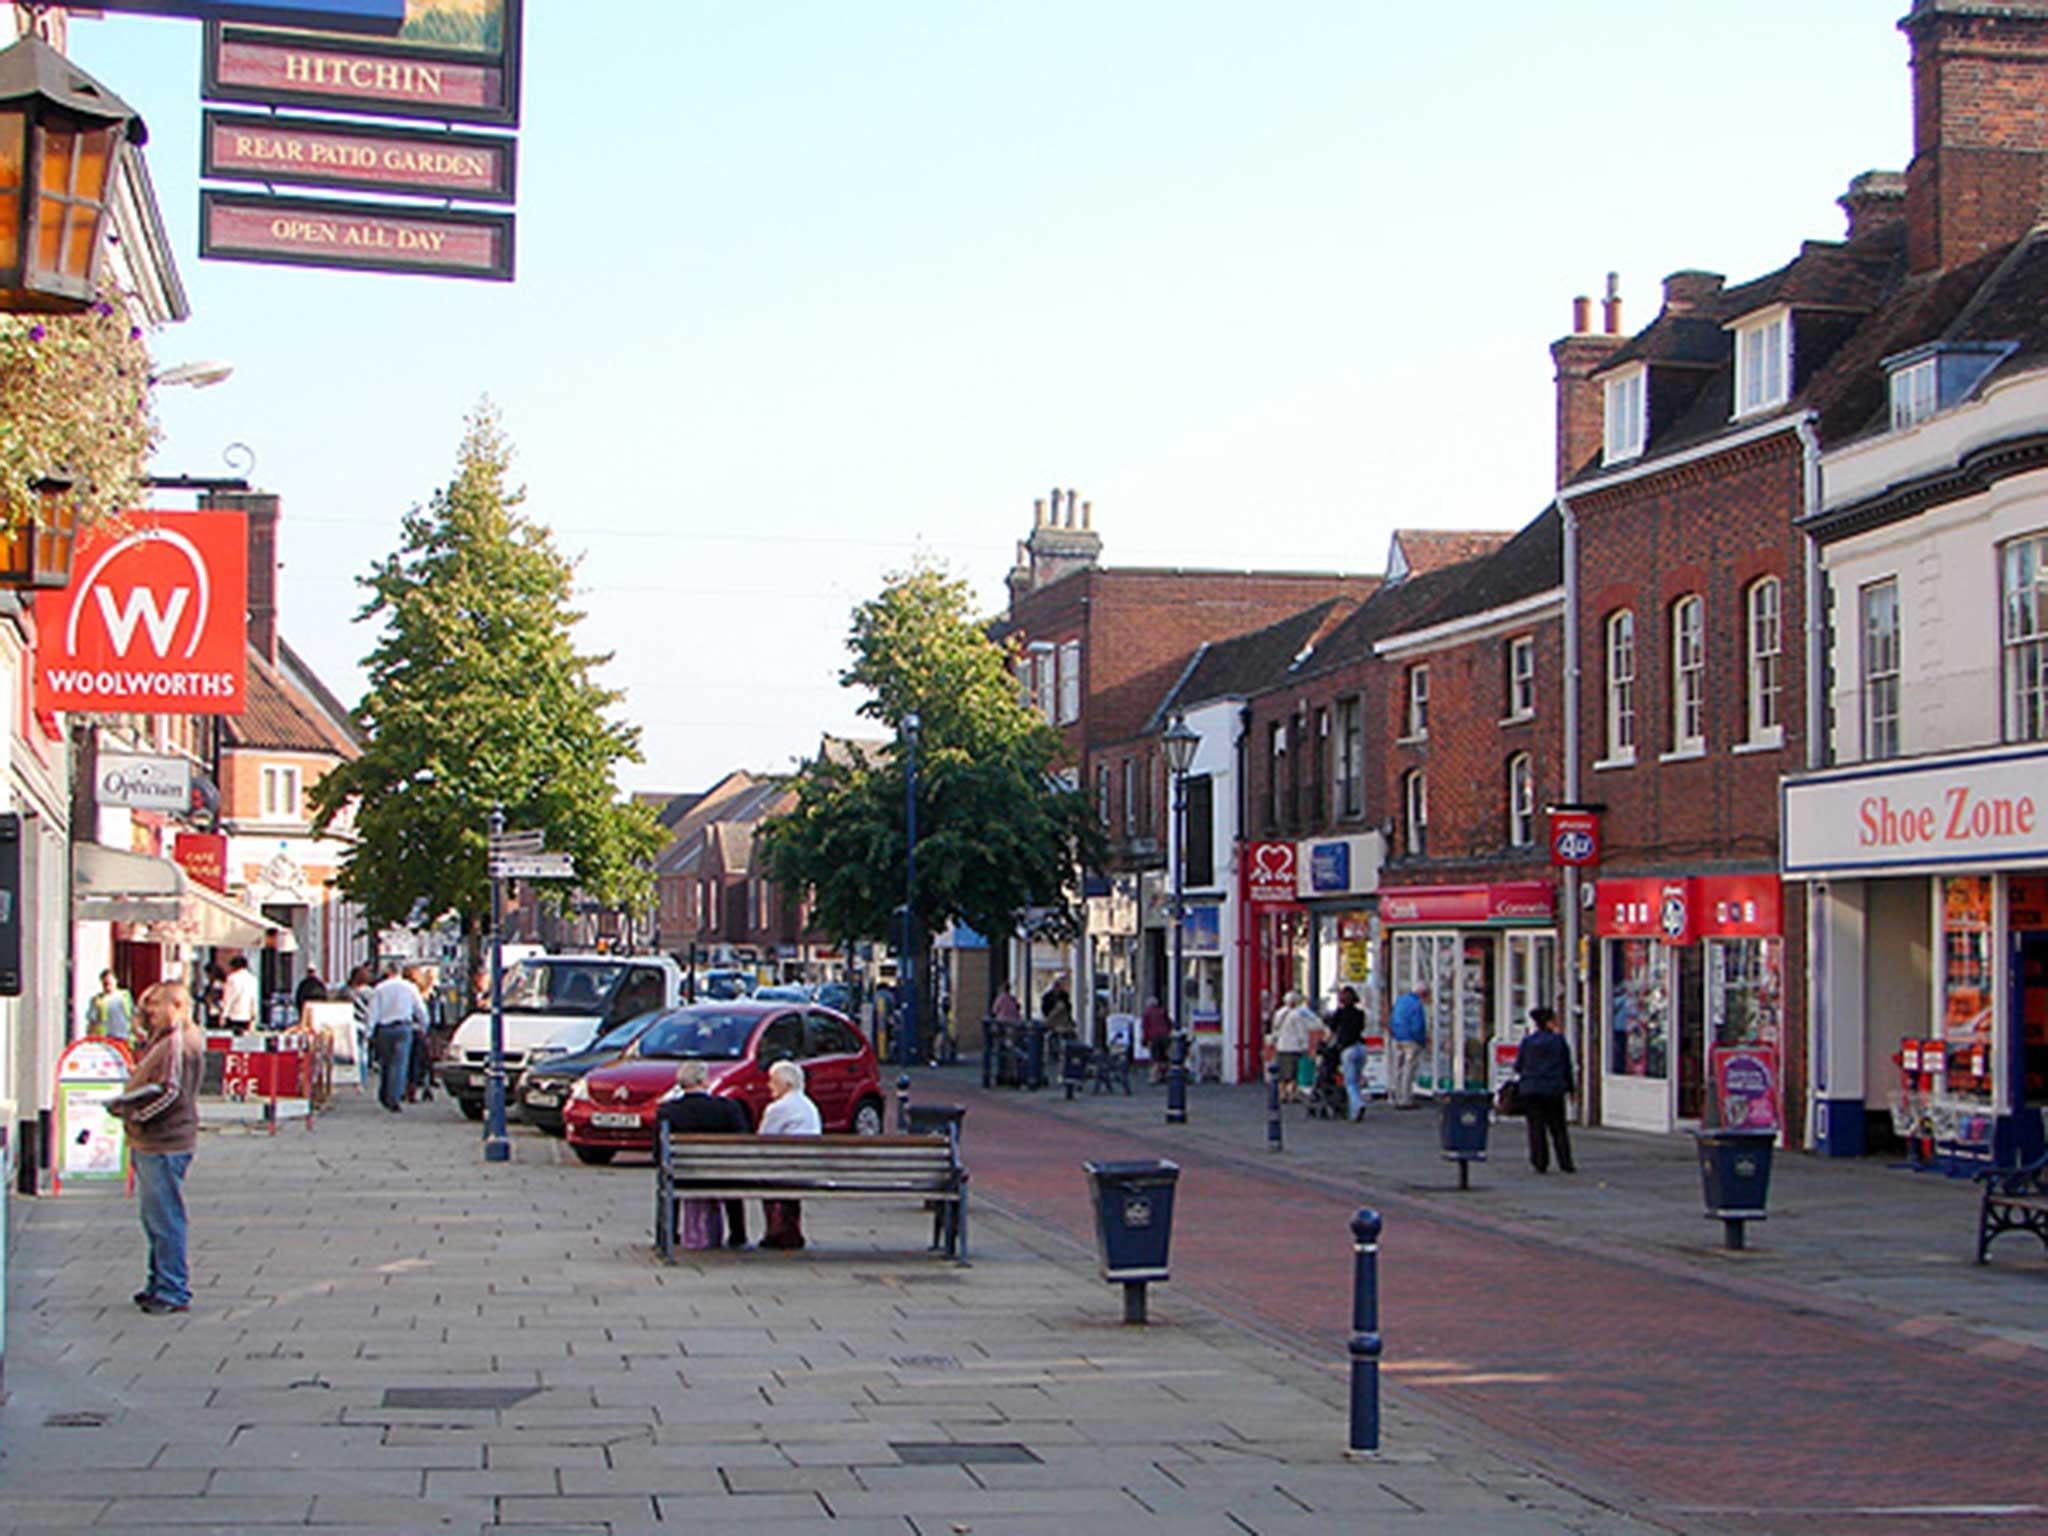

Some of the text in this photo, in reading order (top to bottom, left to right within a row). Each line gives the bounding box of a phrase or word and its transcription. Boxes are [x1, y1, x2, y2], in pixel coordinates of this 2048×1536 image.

[285, 54, 443, 95] HITCHIN
[236, 136, 484, 177] REAR PATIO GARDEN
[271, 218, 446, 251] OPEN ALL DAY
[93, 585, 191, 659] W
[47, 669, 236, 697] WOOLWORTHS
[1859, 786, 2036, 847] Shoe Zone
